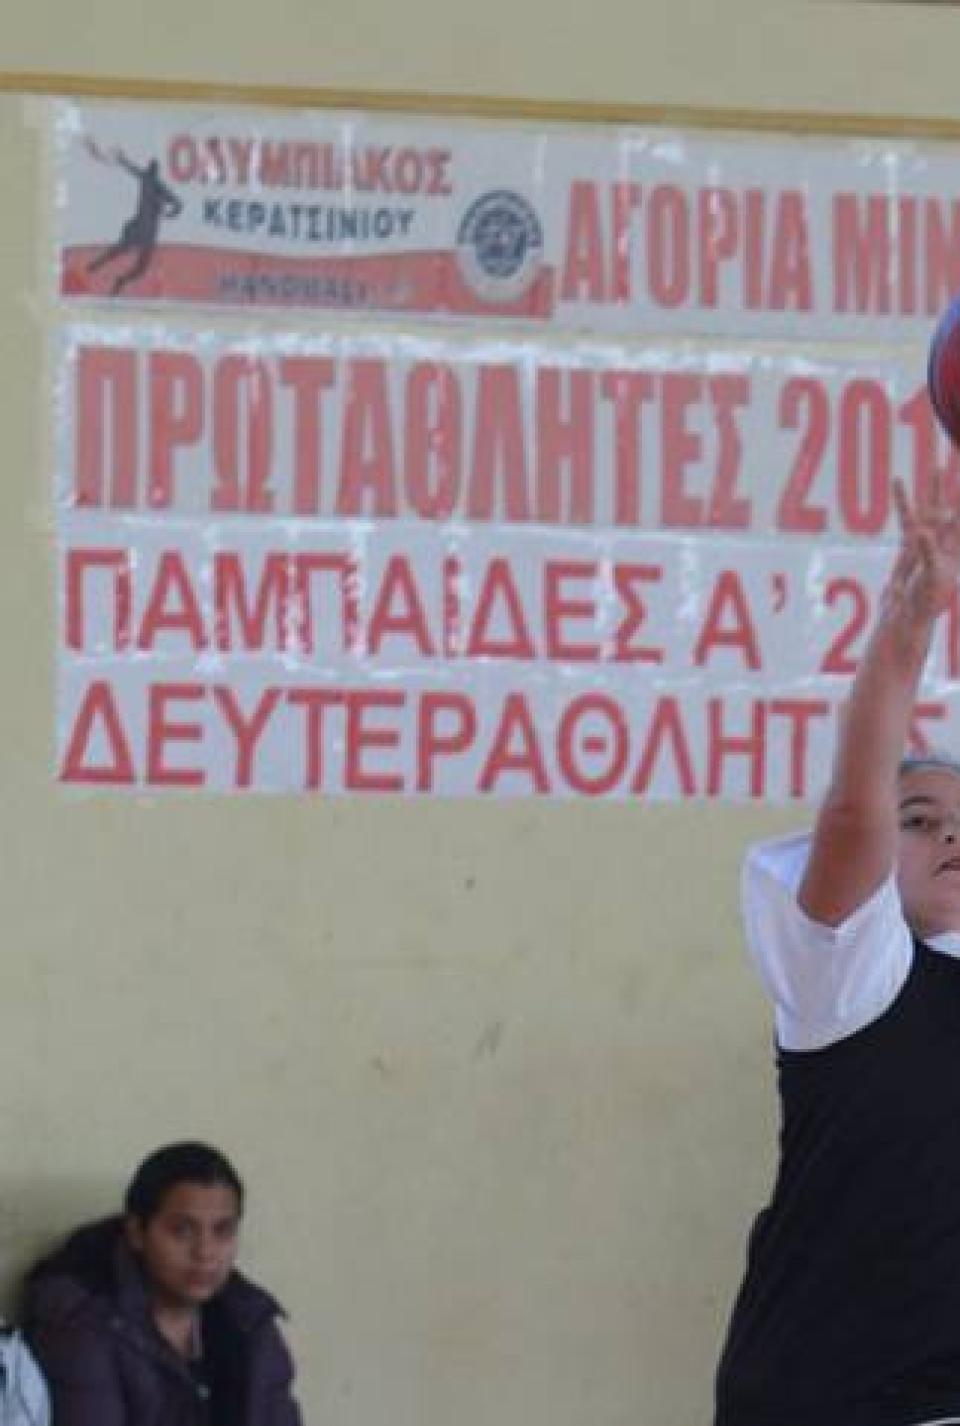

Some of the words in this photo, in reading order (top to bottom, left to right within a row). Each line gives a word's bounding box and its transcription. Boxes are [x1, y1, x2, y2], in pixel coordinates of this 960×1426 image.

[203, 198, 416, 242] ΚΕΡΑΤΣΙΝΙΟΥ
[561, 179, 812, 312] ΑΓΟΡΙΑ
[75, 346, 752, 528] ΠΡΩΤΑΘΛΗΤΕΣ
[65, 548, 663, 663] ΠΑΜΠΑΙΔΕΣ
[58, 679, 948, 802] ΔΕΥΤΕΡΑΘΛΗΤΣ
